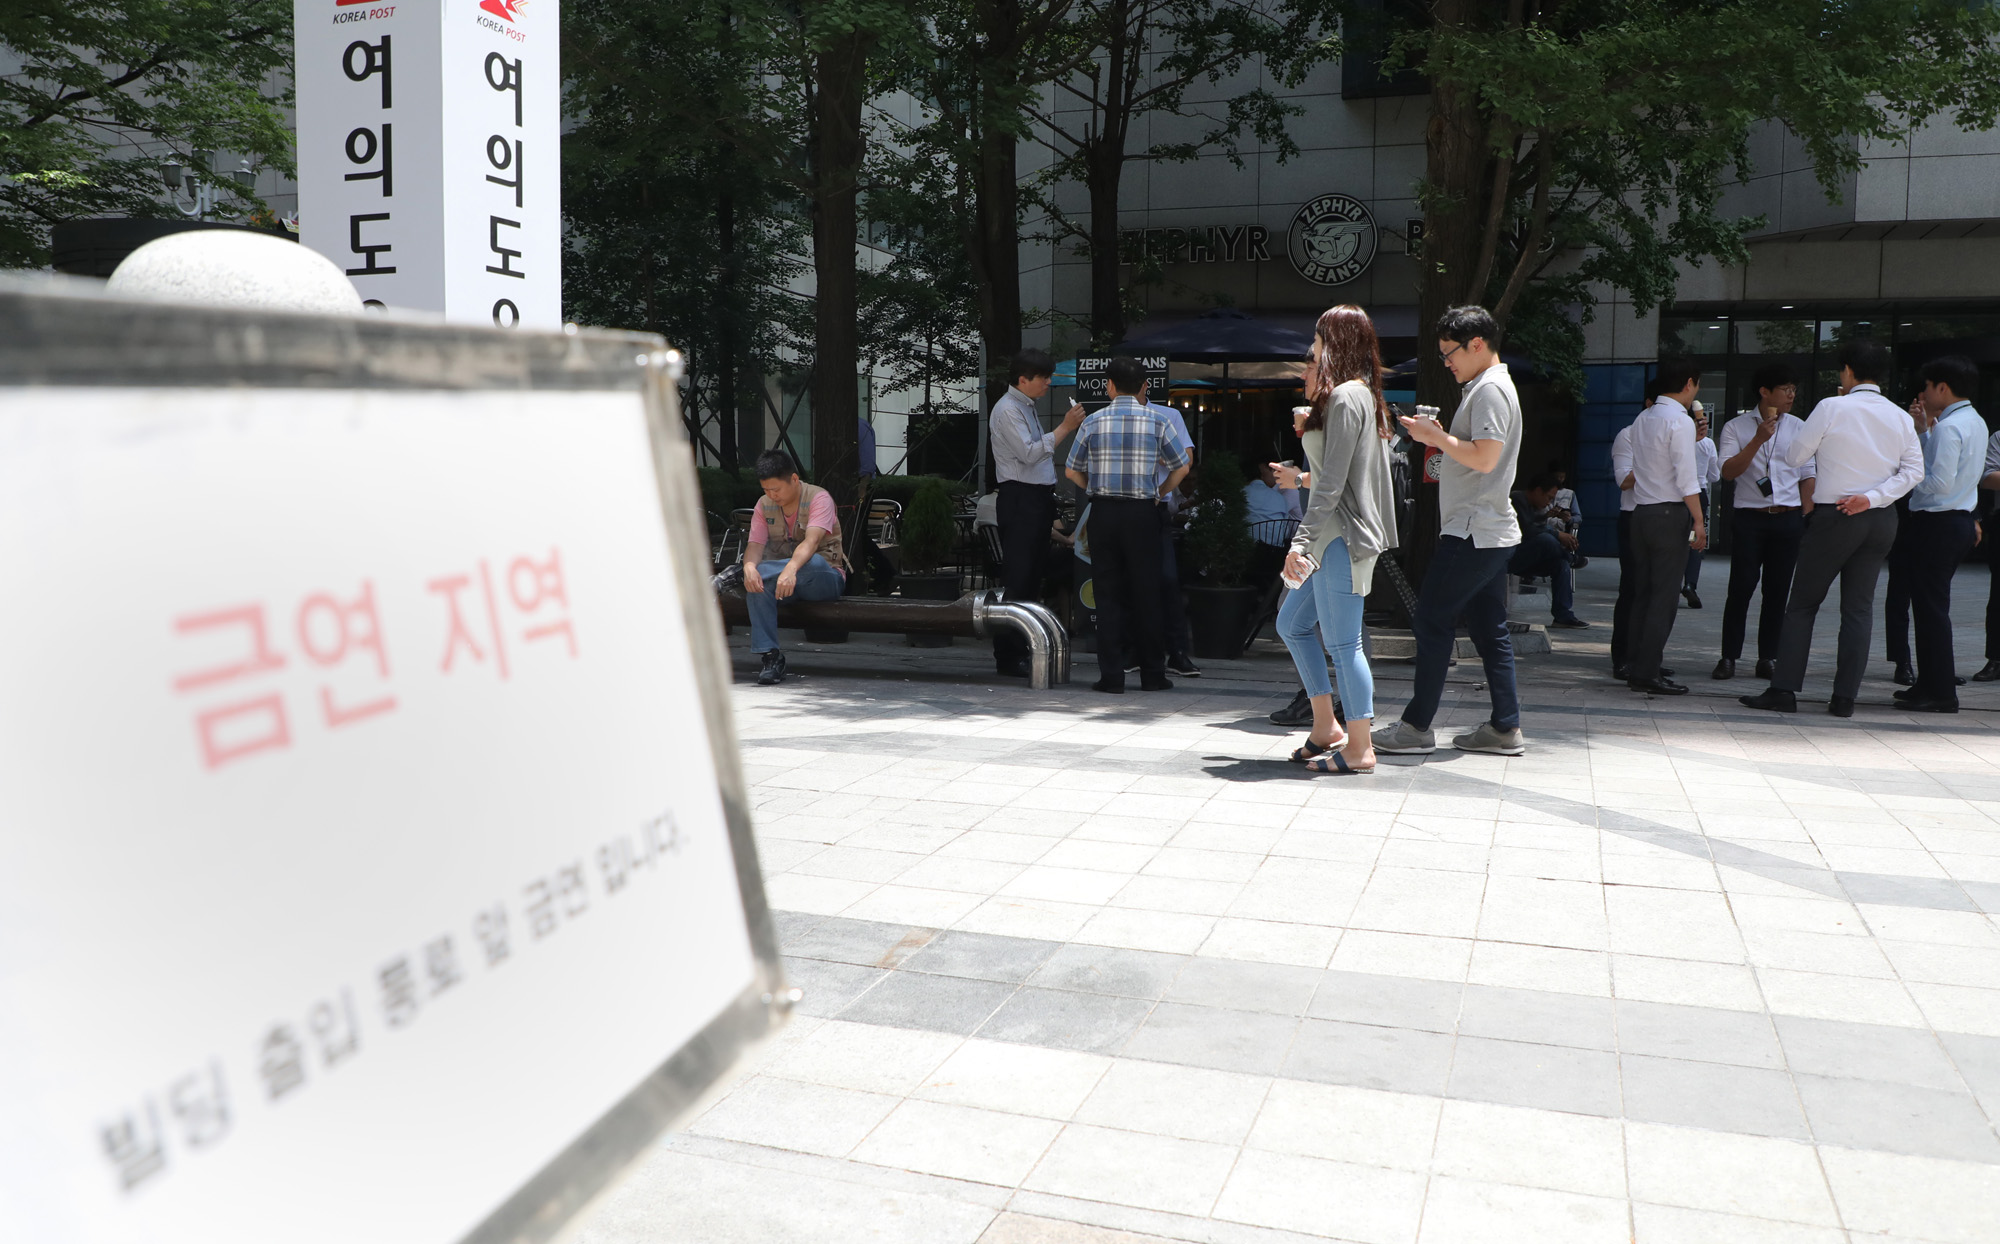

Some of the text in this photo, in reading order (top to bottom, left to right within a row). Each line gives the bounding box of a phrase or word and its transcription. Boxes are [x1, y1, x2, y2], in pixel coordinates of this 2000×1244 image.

[333, 7, 396, 24] KOREA POST
[477, 15, 526, 43] KOREA POST
[342, 34, 397, 315] 여의도
[1301, 198, 1363, 224] ZEPHYR
[1120, 223, 1271, 265] ZEPHYR
[1303, 260, 1361, 282] BEANS
[1146, 377, 1166, 388] SET
[171, 546, 580, 772] 금연 지역
[96, 1054, 235, 1193] 빌딩
[254, 984, 363, 1104] 출입
[376, 932, 466, 1030] 통로
[521, 857, 591, 942] 금연
